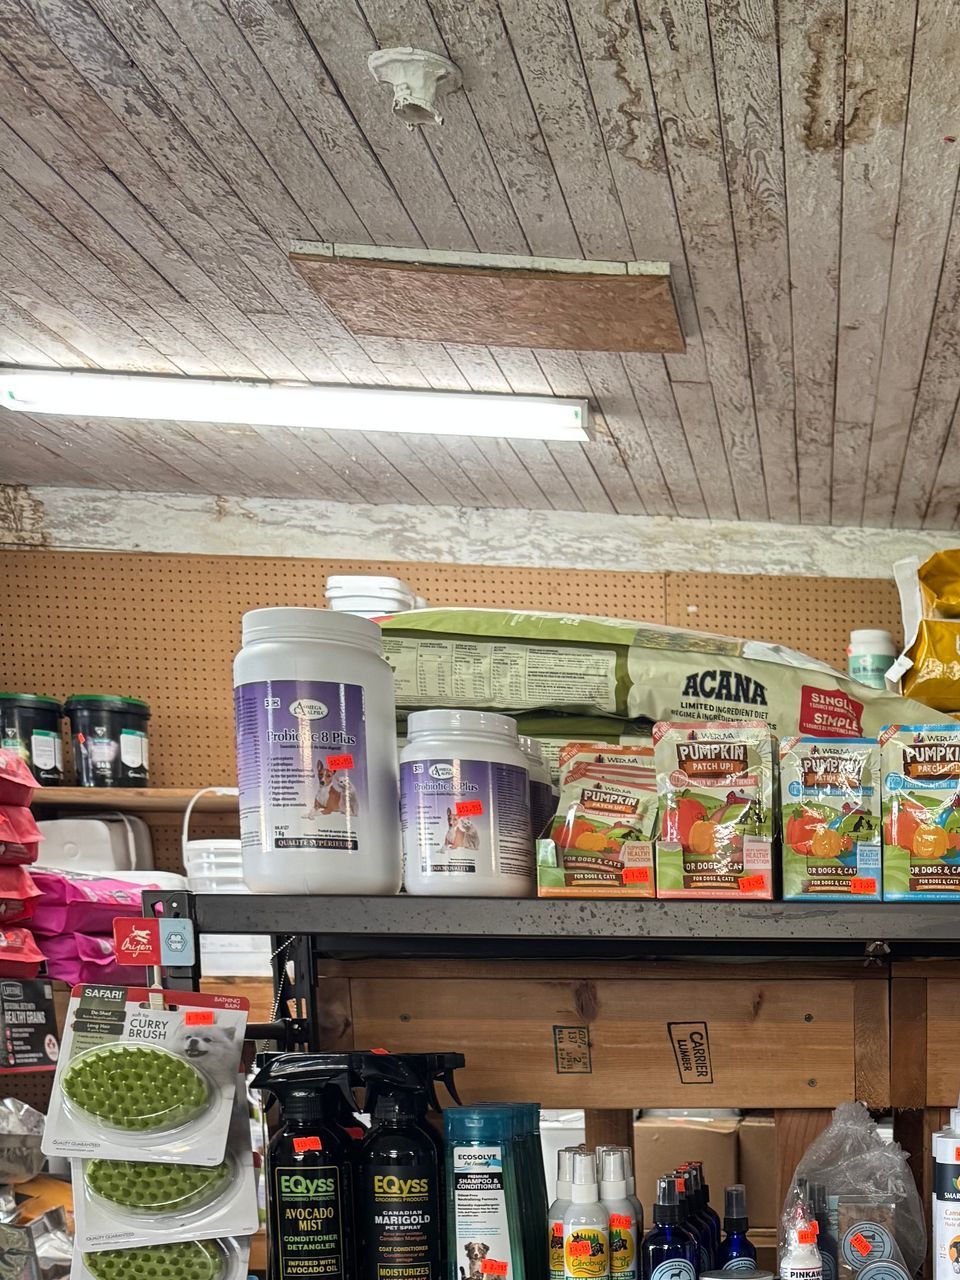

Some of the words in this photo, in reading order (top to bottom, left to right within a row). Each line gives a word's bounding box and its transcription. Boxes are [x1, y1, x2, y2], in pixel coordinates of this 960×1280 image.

[681, 669, 768, 707] ACANA
[680, 702, 714, 713] LIMITED
[715, 705, 754, 719] INGREDIENT
[753, 711, 769, 721] DIET
[813, 712, 859, 731] SIMPLE
[679, 743, 744, 761] PUMPKIN
[584, 790, 638, 806] PUMPKIN
[84, 988, 124, 1001] SAFARI
[214, 996, 241, 1005] BATHING
[129, 1018, 169, 1031] CURRY
[128, 1028, 167, 1041] BRUSH
[677, 1038, 692, 1073] LUMBER
[688, 1030, 709, 1078] CARRIER
[457, 1153, 497, 1162] ECOSOLVE
[456, 1183, 502, 1191] CONDITIONER
[285, 1206, 334, 1220] AVOCADO
[298, 1219, 322, 1232] MIST
[374, 1215, 431, 1225] MARIGOLD
[284, 1234, 338, 1243] CONDITIONER
[287, 1242, 336, 1251] DETANGLER
[379, 1267, 430, 1277] MOISTURIZES
